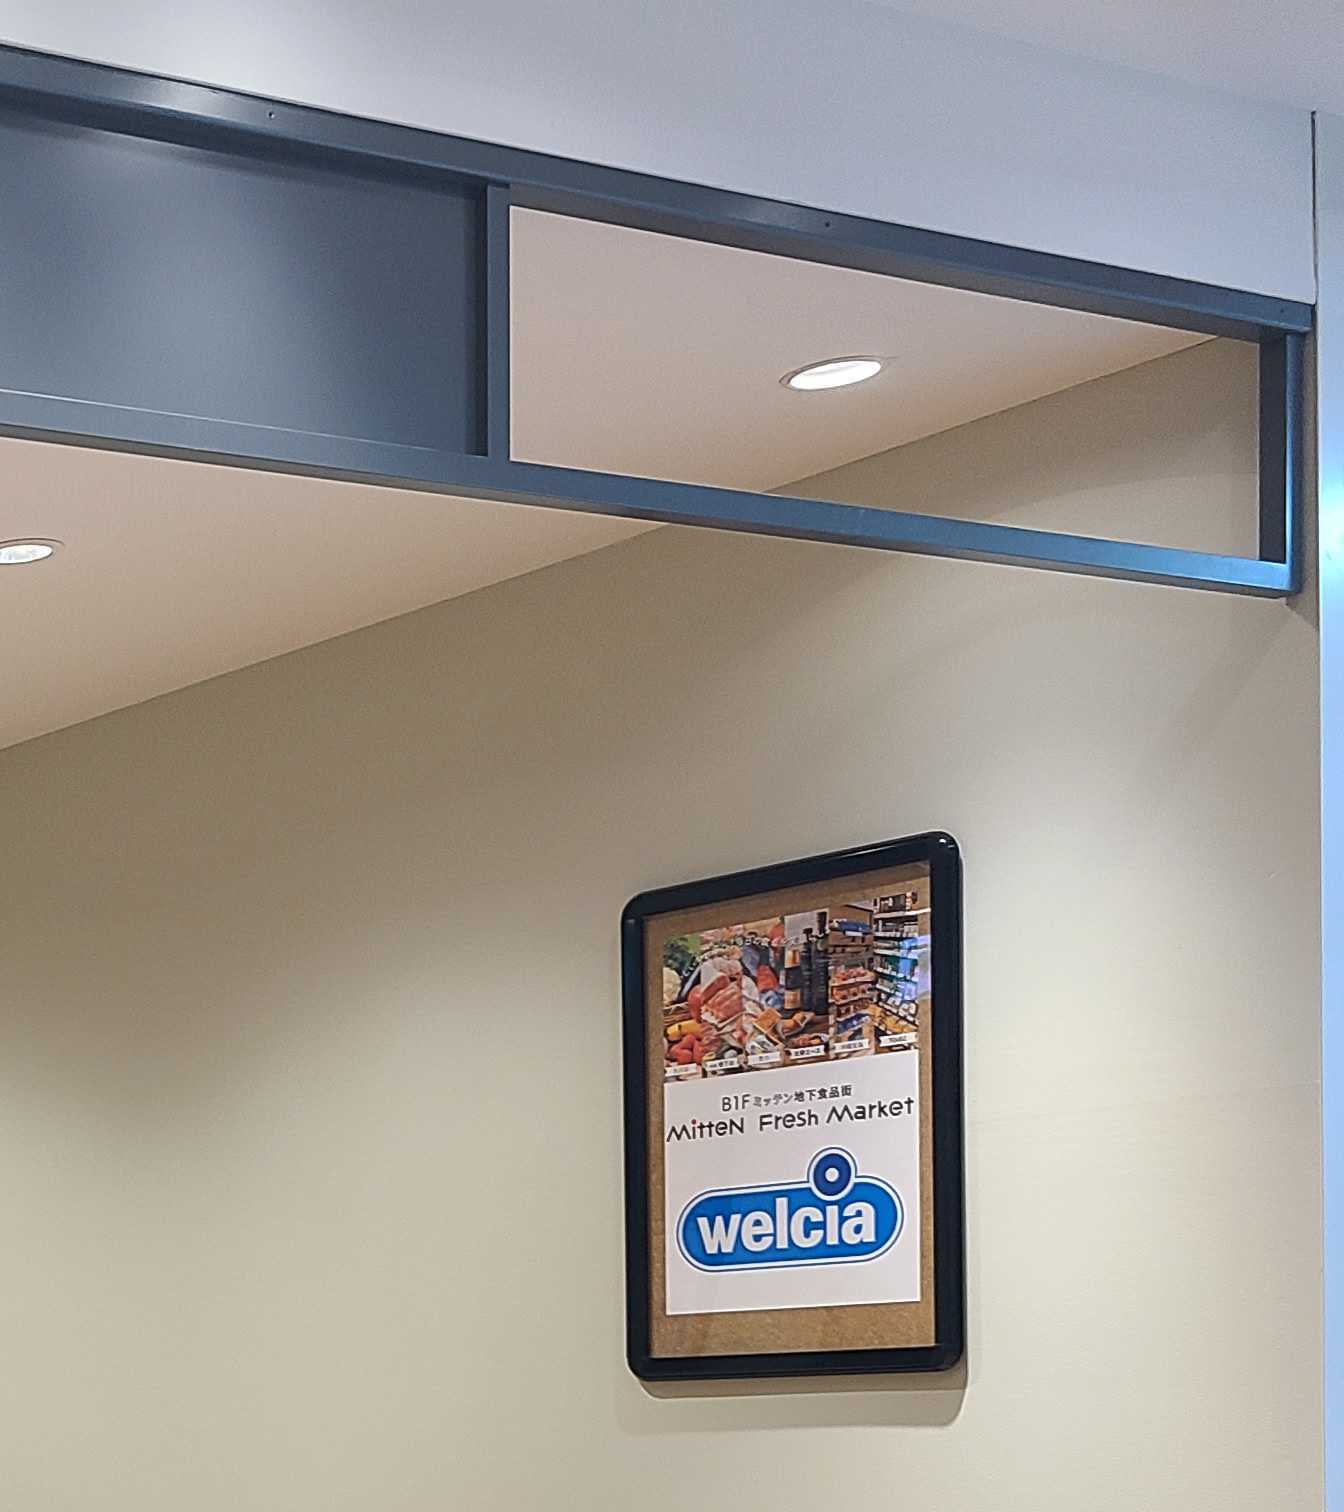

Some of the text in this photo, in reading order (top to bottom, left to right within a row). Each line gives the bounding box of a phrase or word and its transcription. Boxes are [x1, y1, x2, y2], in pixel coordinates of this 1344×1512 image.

[665, 1096, 915, 1143] MitteN Fresh Market
[721, 1084, 852, 1112] B1F ミッテン地下食品街
[696, 1155, 876, 1254] welcia
